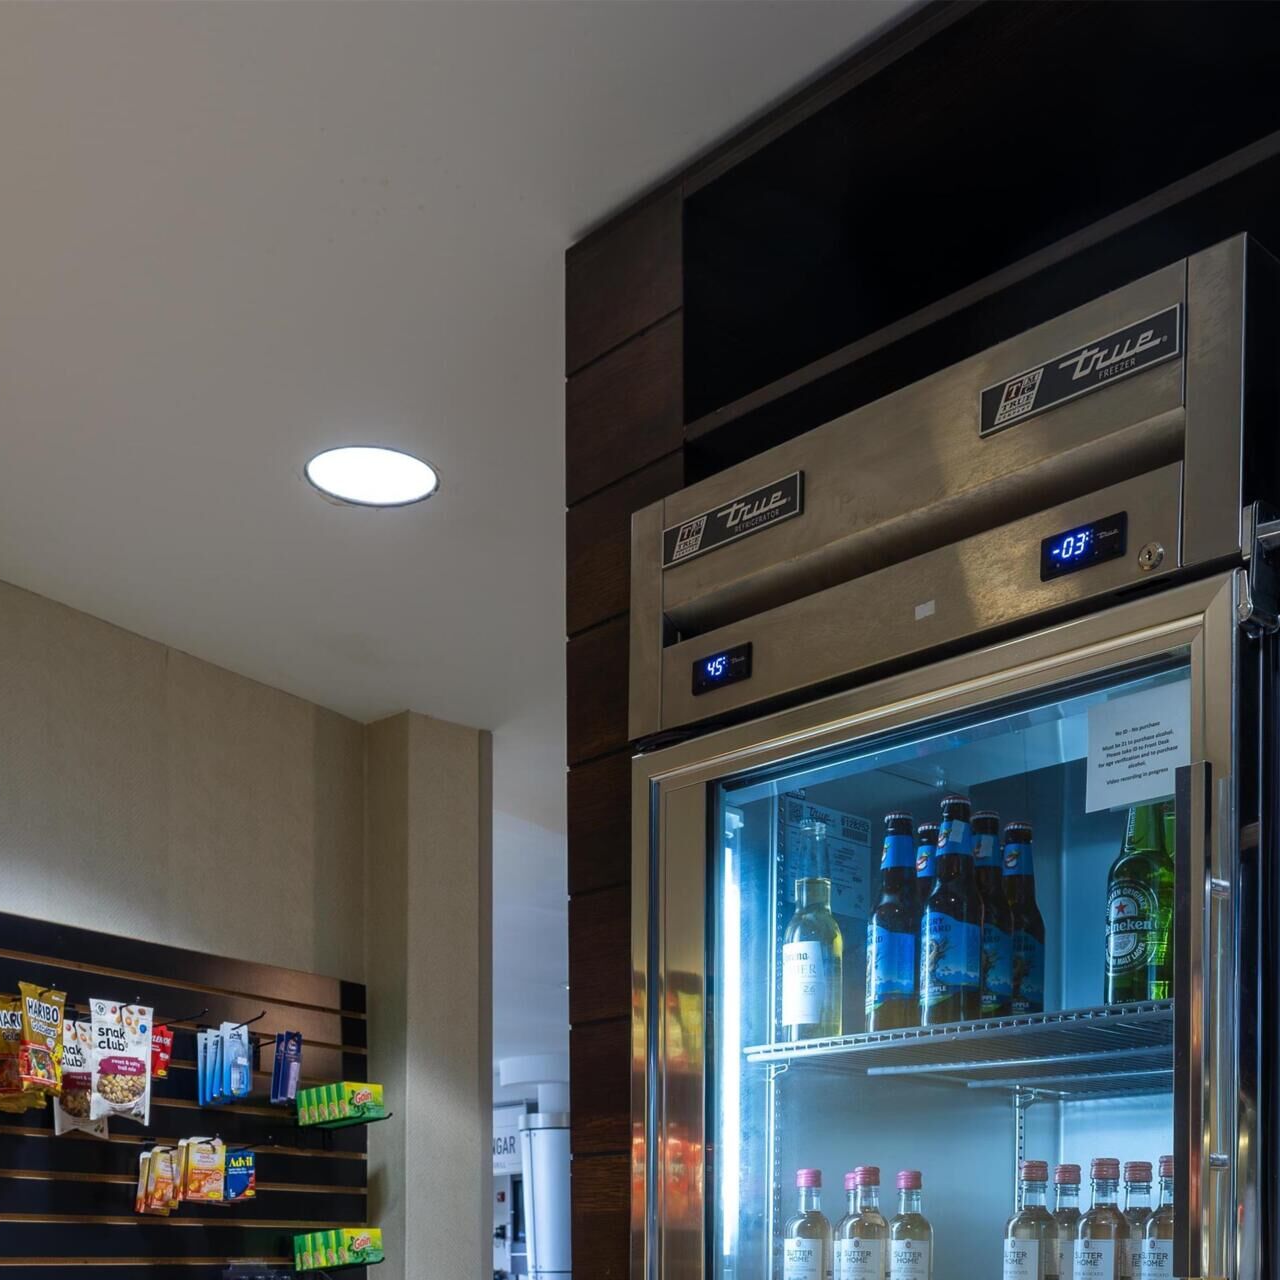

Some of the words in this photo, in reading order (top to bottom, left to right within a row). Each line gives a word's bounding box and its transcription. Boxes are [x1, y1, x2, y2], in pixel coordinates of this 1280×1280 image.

[1099, 358, 1136, 379] FREEZER
[734, 508, 780, 533] REFRIGERATOR
[1140, 721, 1160, 731] purchase
[1134, 734, 1155, 745] purchase
[1115, 754, 1141, 765] verification
[1157, 745, 1178, 755] purchase
[1120, 773, 1142, 782] recording
[1148, 767, 1169, 776] progress
[25, 996, 60, 1025] HARIBO
[97, 1027, 126, 1040] snak
[97, 1038, 126, 1052] club
[355, 1090, 373, 1105] Gain
[228, 1156, 253, 1168] Advil
[354, 1235, 371, 1251] Gain
[843, 1250, 872, 1258] SUTTER
[846, 1256, 868, 1264] HOME
[893, 1250, 922, 1258] SUTTER
[896, 1257, 919, 1265] HOME
